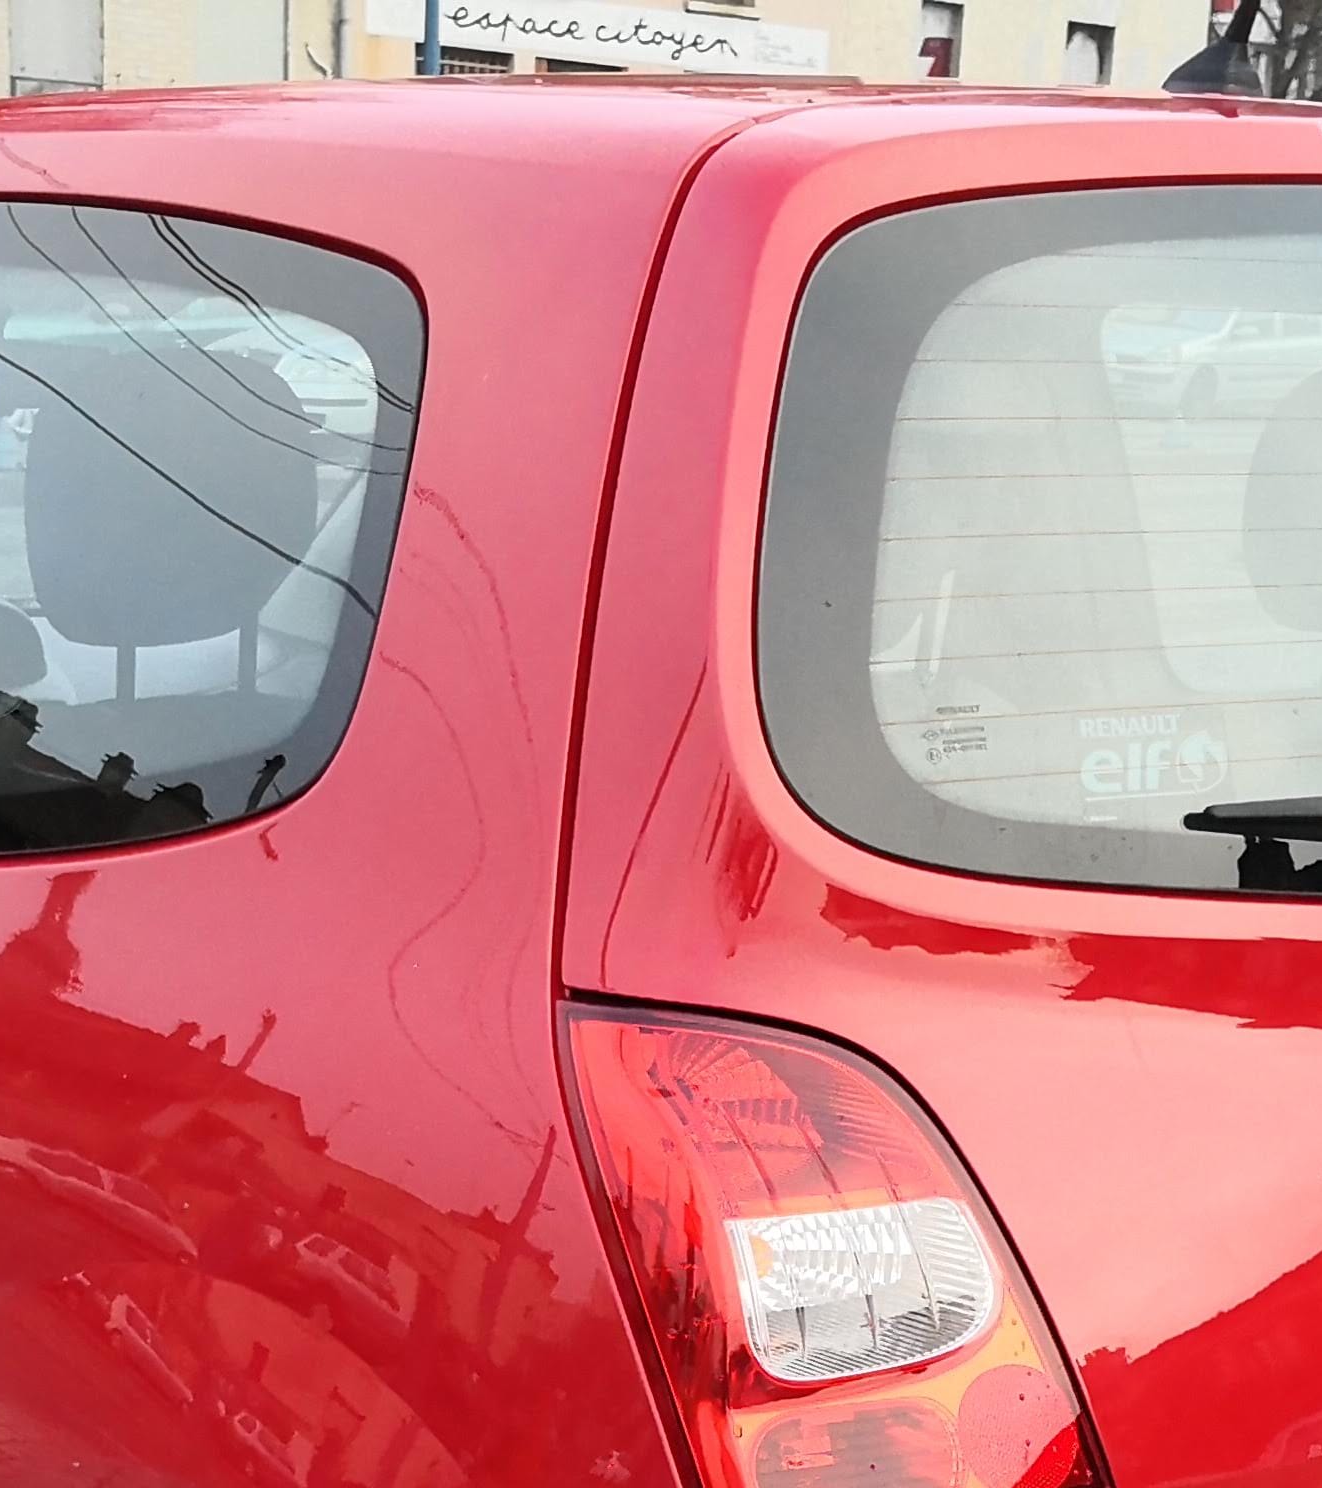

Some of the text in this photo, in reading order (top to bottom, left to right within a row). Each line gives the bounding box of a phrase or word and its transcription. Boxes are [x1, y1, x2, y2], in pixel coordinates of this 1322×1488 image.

[445, 6, 584, 41] espace
[596, 18, 738, 60] citoyen
[1079, 713, 1180, 737] RENAULT
[1081, 739, 1172, 793] elf
